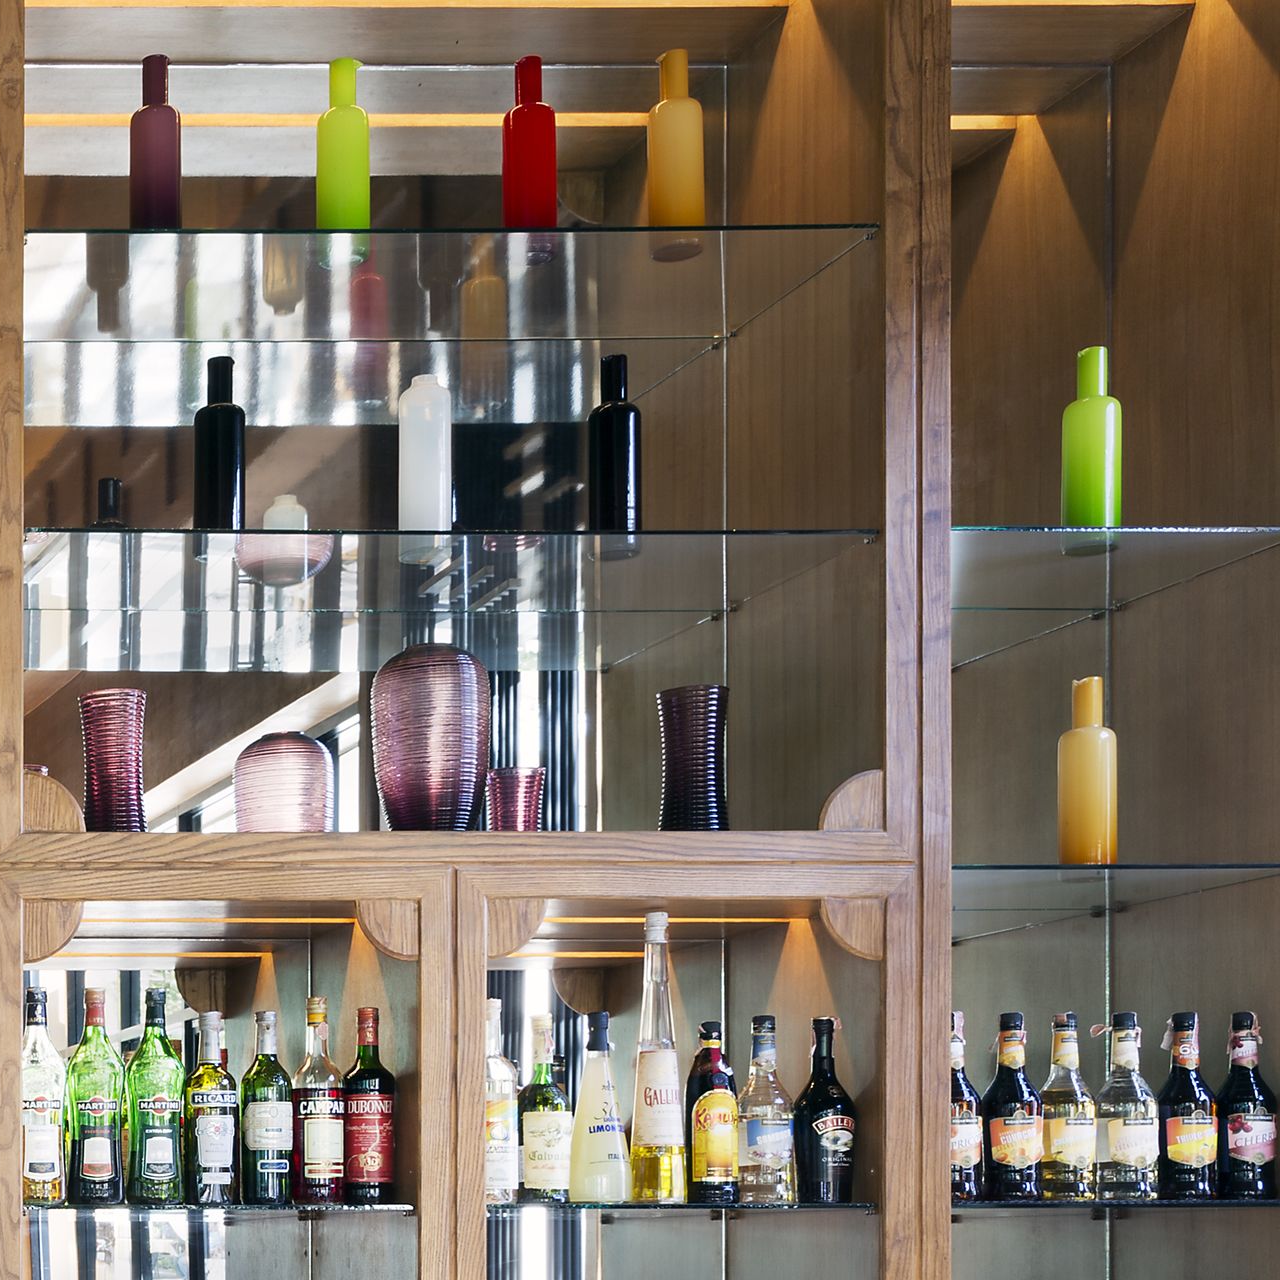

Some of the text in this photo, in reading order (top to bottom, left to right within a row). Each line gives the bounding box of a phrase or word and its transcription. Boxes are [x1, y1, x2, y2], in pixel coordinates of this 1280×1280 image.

[194, 1094, 236, 1104] RICARD
[22, 1101, 60, 1109] MARTINI
[77, 1102, 116, 1110] MARTINI
[140, 1101, 179, 1109] MARTINI
